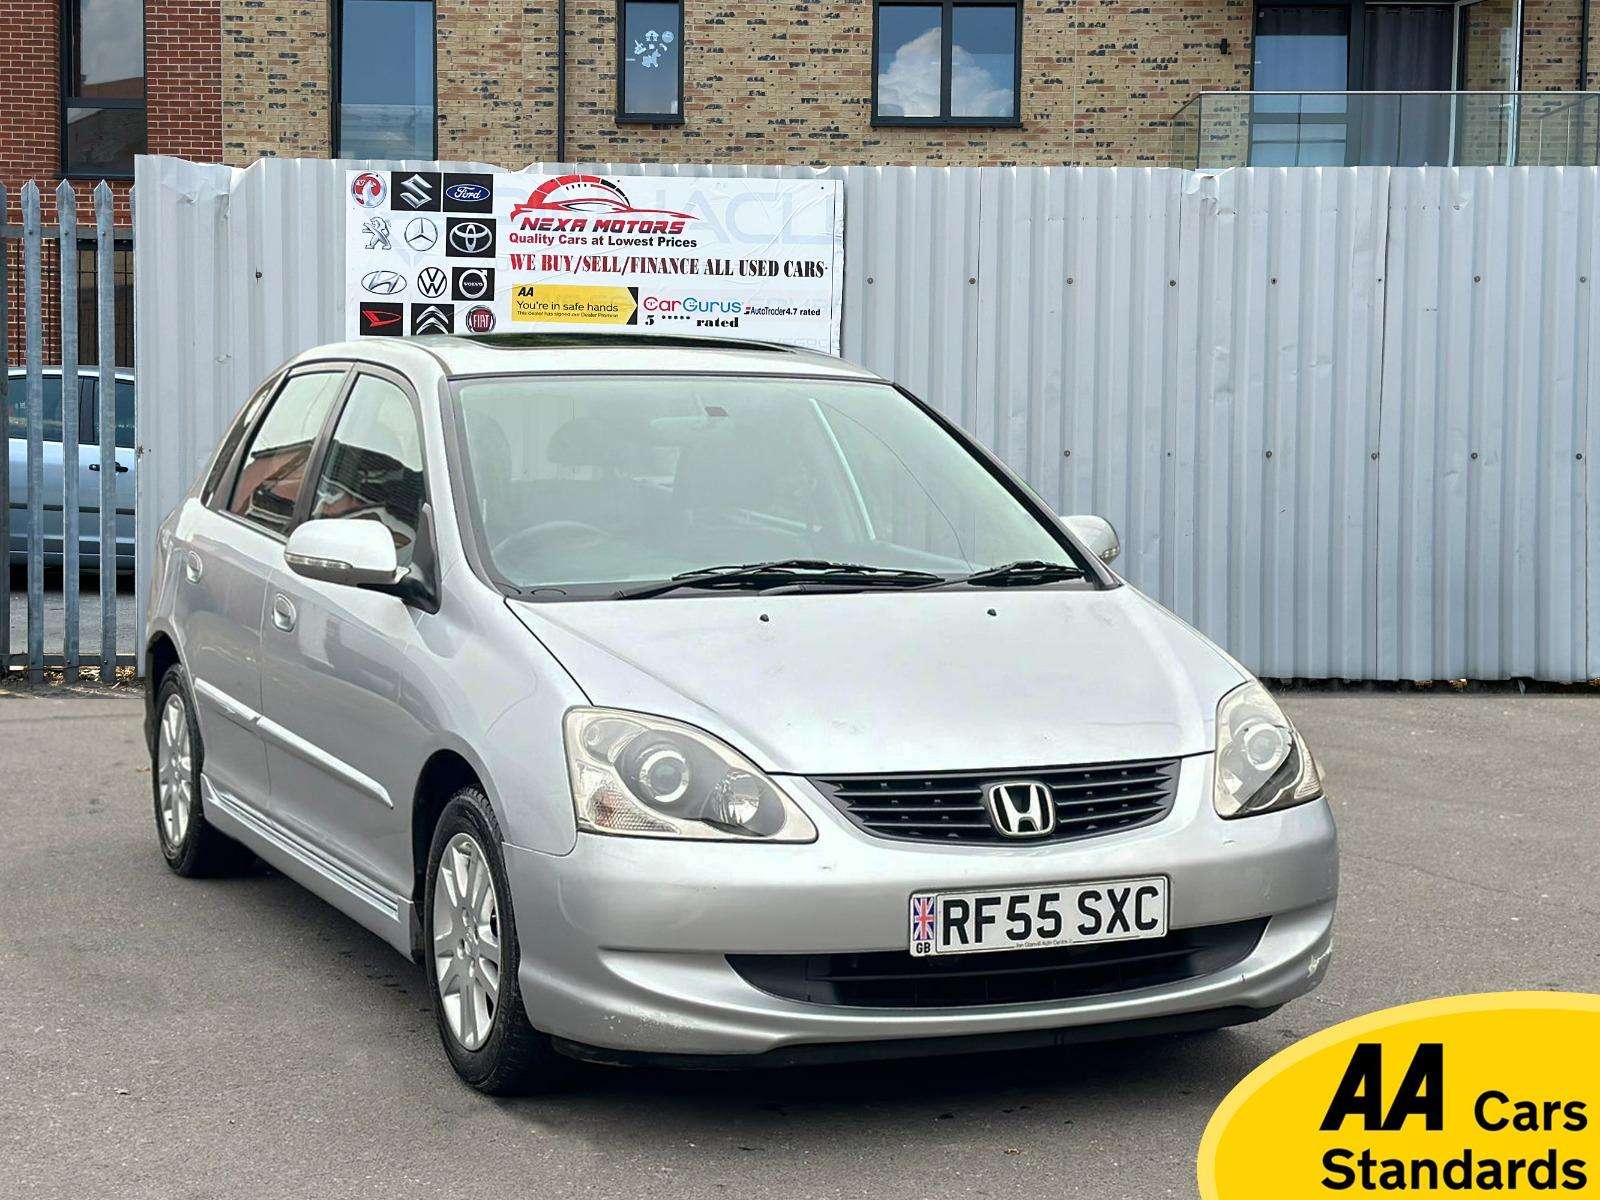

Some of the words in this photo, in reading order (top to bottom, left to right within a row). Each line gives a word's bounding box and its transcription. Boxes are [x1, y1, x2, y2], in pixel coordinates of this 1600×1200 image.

[454, 186, 481, 199] Ford
[520, 217, 588, 231] NEXA
[592, 219, 686, 235] MOTORS
[509, 233, 555, 245] Quality
[558, 234, 587, 245] Cars
[591, 235, 604, 246] at
[608, 235, 653, 247] Lowest
[657, 237, 697, 248] Prices
[509, 253, 536, 271] WE
[704, 258, 734, 276] ALL
[739, 259, 779, 277] USED
[784, 260, 825, 278] CARS
[517, 286, 534, 297] AA
[516, 300, 549, 310] You're
[551, 301, 560, 310] in
[563, 302, 585, 311] safe
[587, 303, 619, 312] hands
[643, 297, 742, 313] CarGurus
[800, 307, 821, 316] rated
[473, 314, 490, 328] FIAT
[645, 314, 655, 326] 5
[696, 317, 739, 328] rated
[942, 893, 1063, 946] RF55
[1077, 885, 1159, 936] SXC
[916, 940, 931, 954] GB
